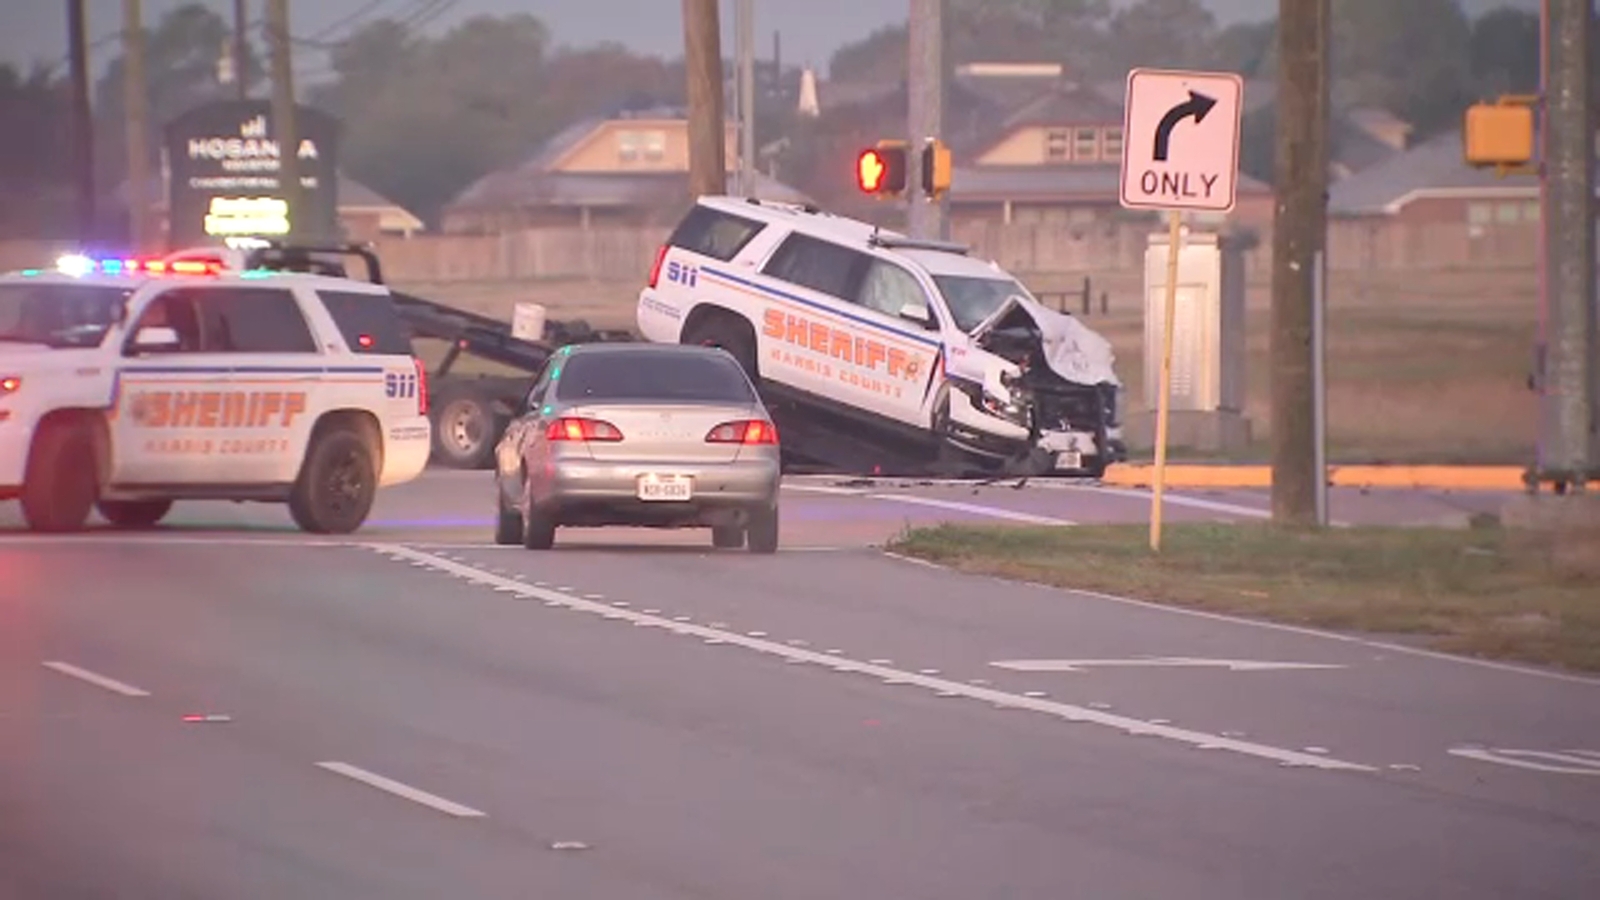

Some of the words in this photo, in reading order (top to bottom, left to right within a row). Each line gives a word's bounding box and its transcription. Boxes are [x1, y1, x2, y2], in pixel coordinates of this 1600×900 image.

[189, 138, 318, 159] HOSANA
[1141, 169, 1219, 198] ONLY
[667, 261, 699, 287] 911
[763, 308, 909, 378] SHERIFF
[385, 373, 415, 398] 911
[771, 348, 832, 378] HARRIS
[839, 368, 902, 399] COUNTY
[145, 391, 307, 428] SHERIFF
[219, 439, 289, 454] COUNTY
